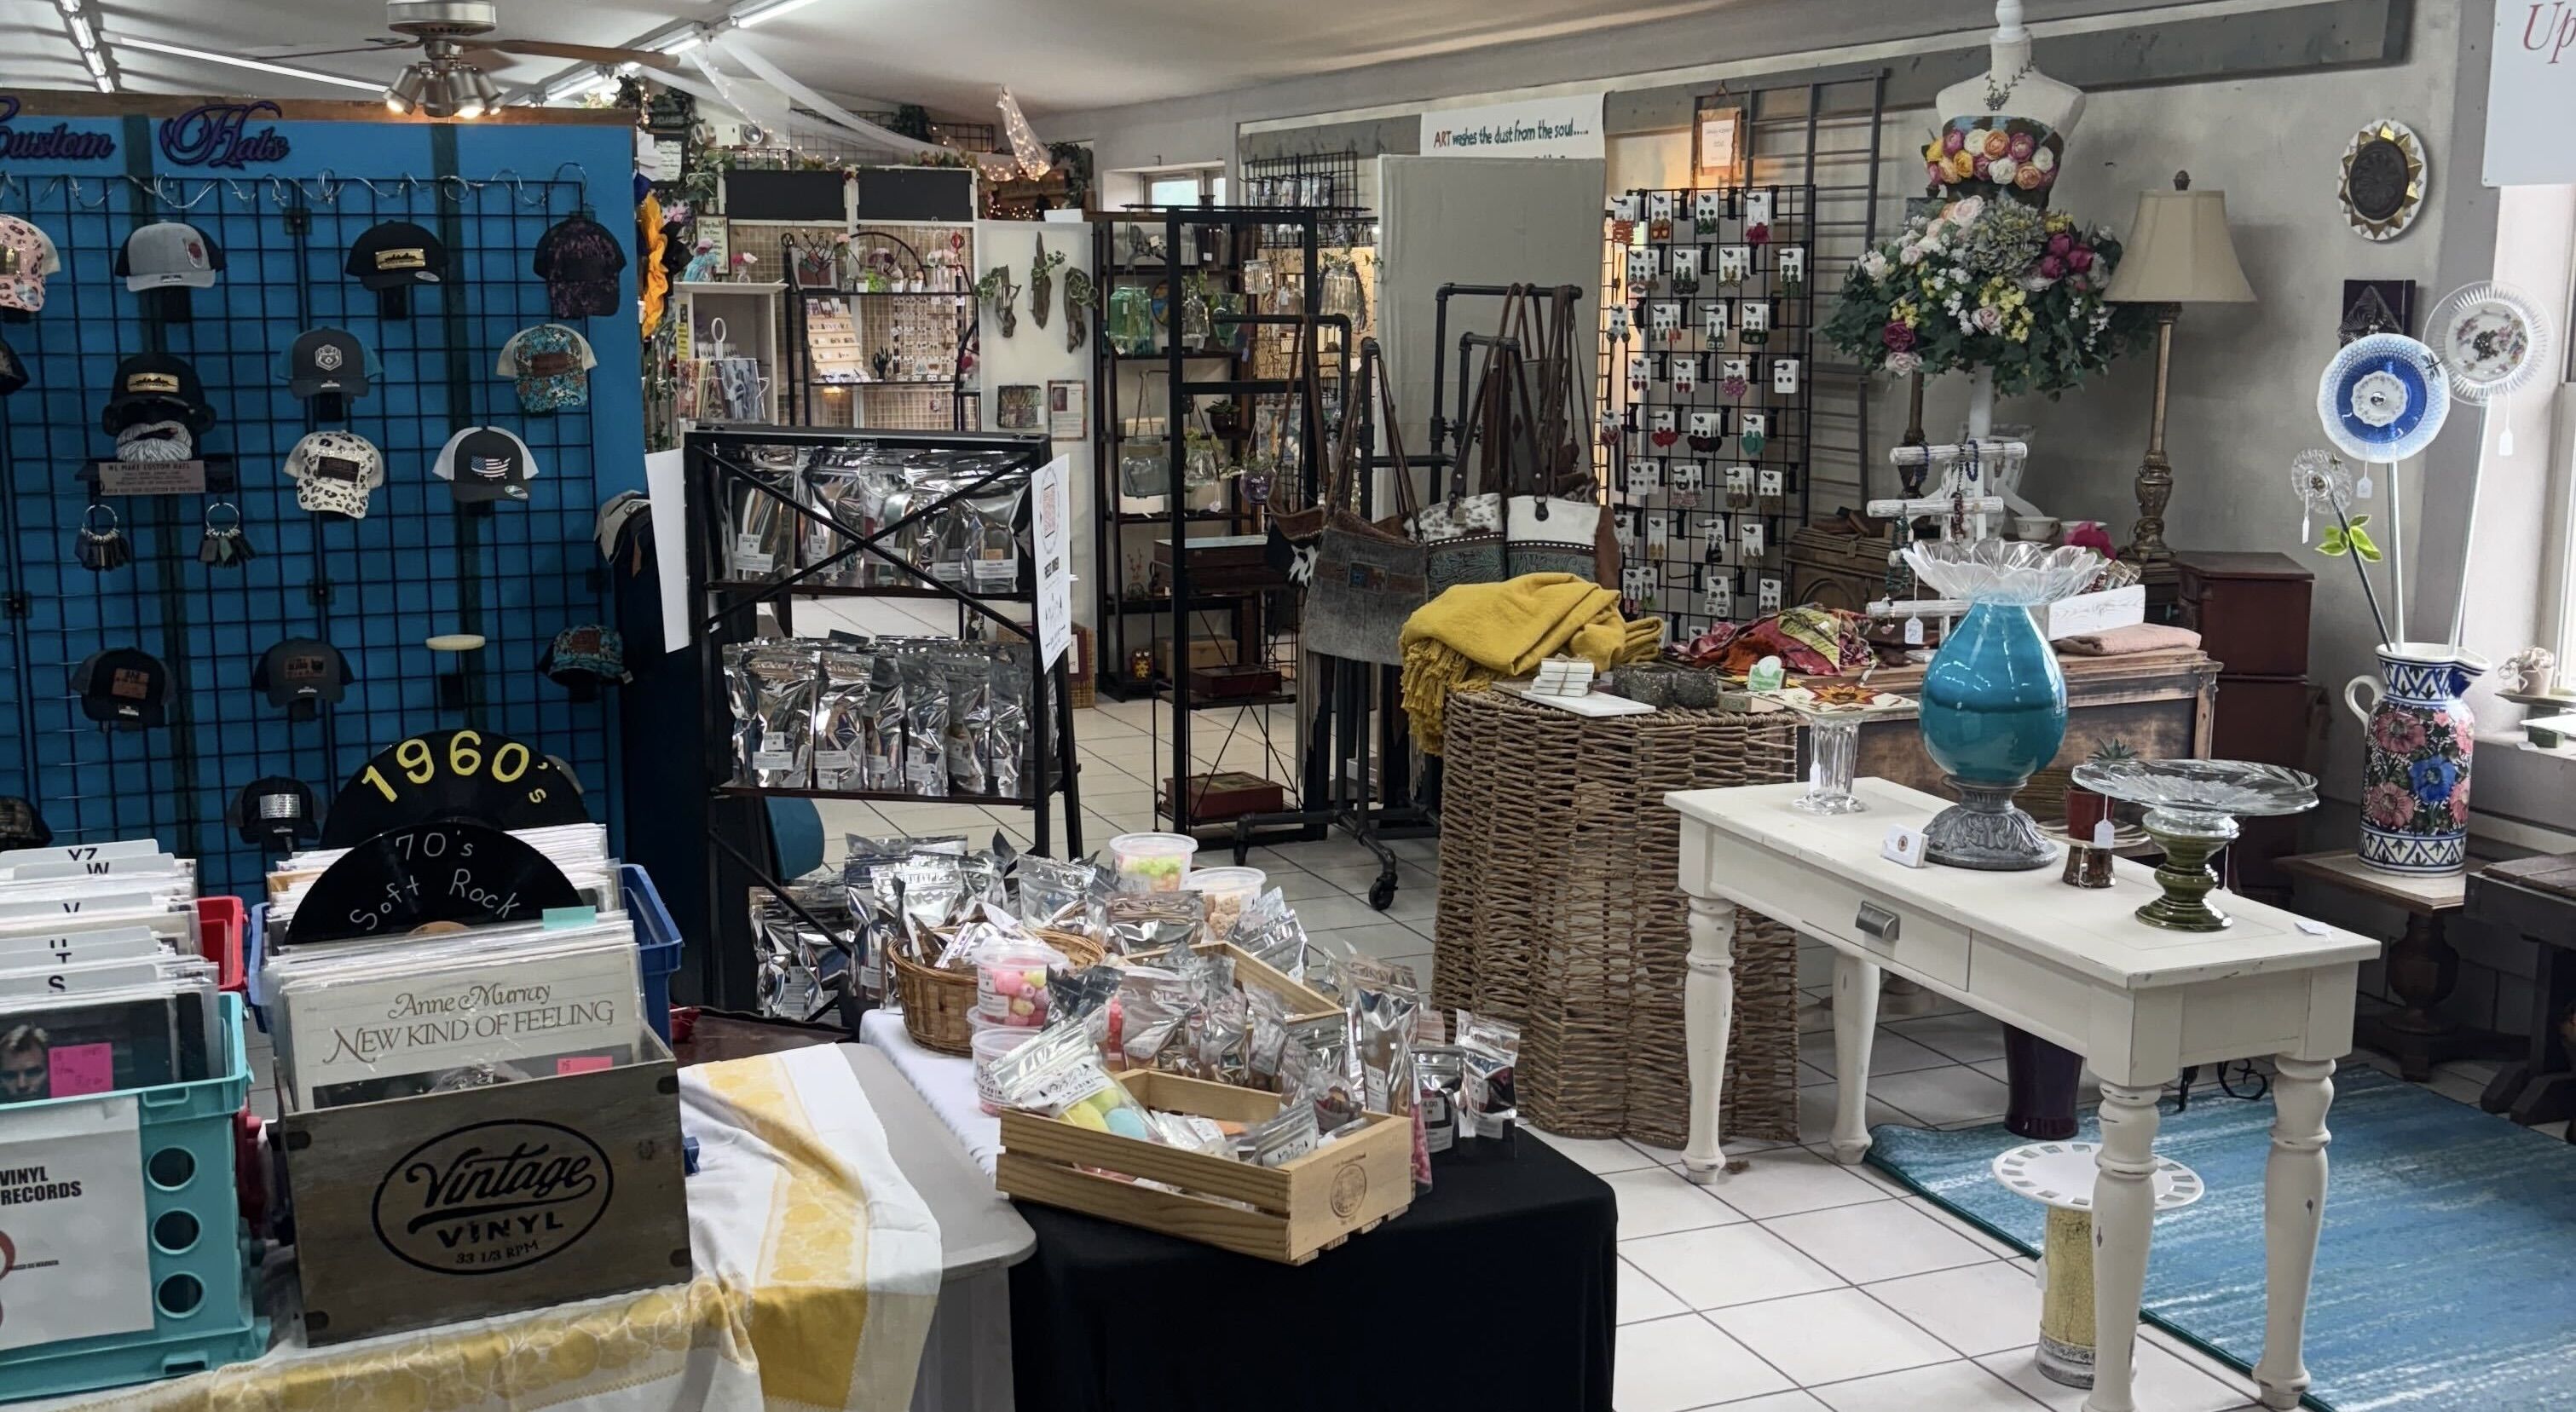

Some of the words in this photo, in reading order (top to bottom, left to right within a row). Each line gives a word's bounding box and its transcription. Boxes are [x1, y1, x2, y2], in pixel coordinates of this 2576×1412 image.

[159, 101, 291, 170] Hats
[1433, 130, 1452, 148] ART
[1452, 127, 1477, 147] washes
[1479, 126, 1492, 144] the
[1494, 125, 1512, 144] dust
[1514, 118, 1534, 142] from
[1538, 119, 1552, 140] the
[396, 829, 474, 861] 70's
[349, 875, 419, 931] Soft
[449, 868, 520, 919] Rock
[49, 976, 66, 993] S
[388, 993, 454, 1019] Anne
[459, 983, 551, 1010] Murray
[323, 1028, 403, 1064] NEW
[407, 1018, 469, 1047] KIND
[475, 1013, 509, 1039] OF
[514, 1000, 615, 1034] FEELING
[0, 1166, 49, 1186] VINYL
[406, 1143, 596, 1209] Vintage
[0, 1181, 82, 1206] RECORDS
[436, 1212, 563, 1248] VINYL
[456, 1252, 475, 1264] 33
[480, 1249, 501, 1263] 1/3
[505, 1239, 539, 1260] RPM
